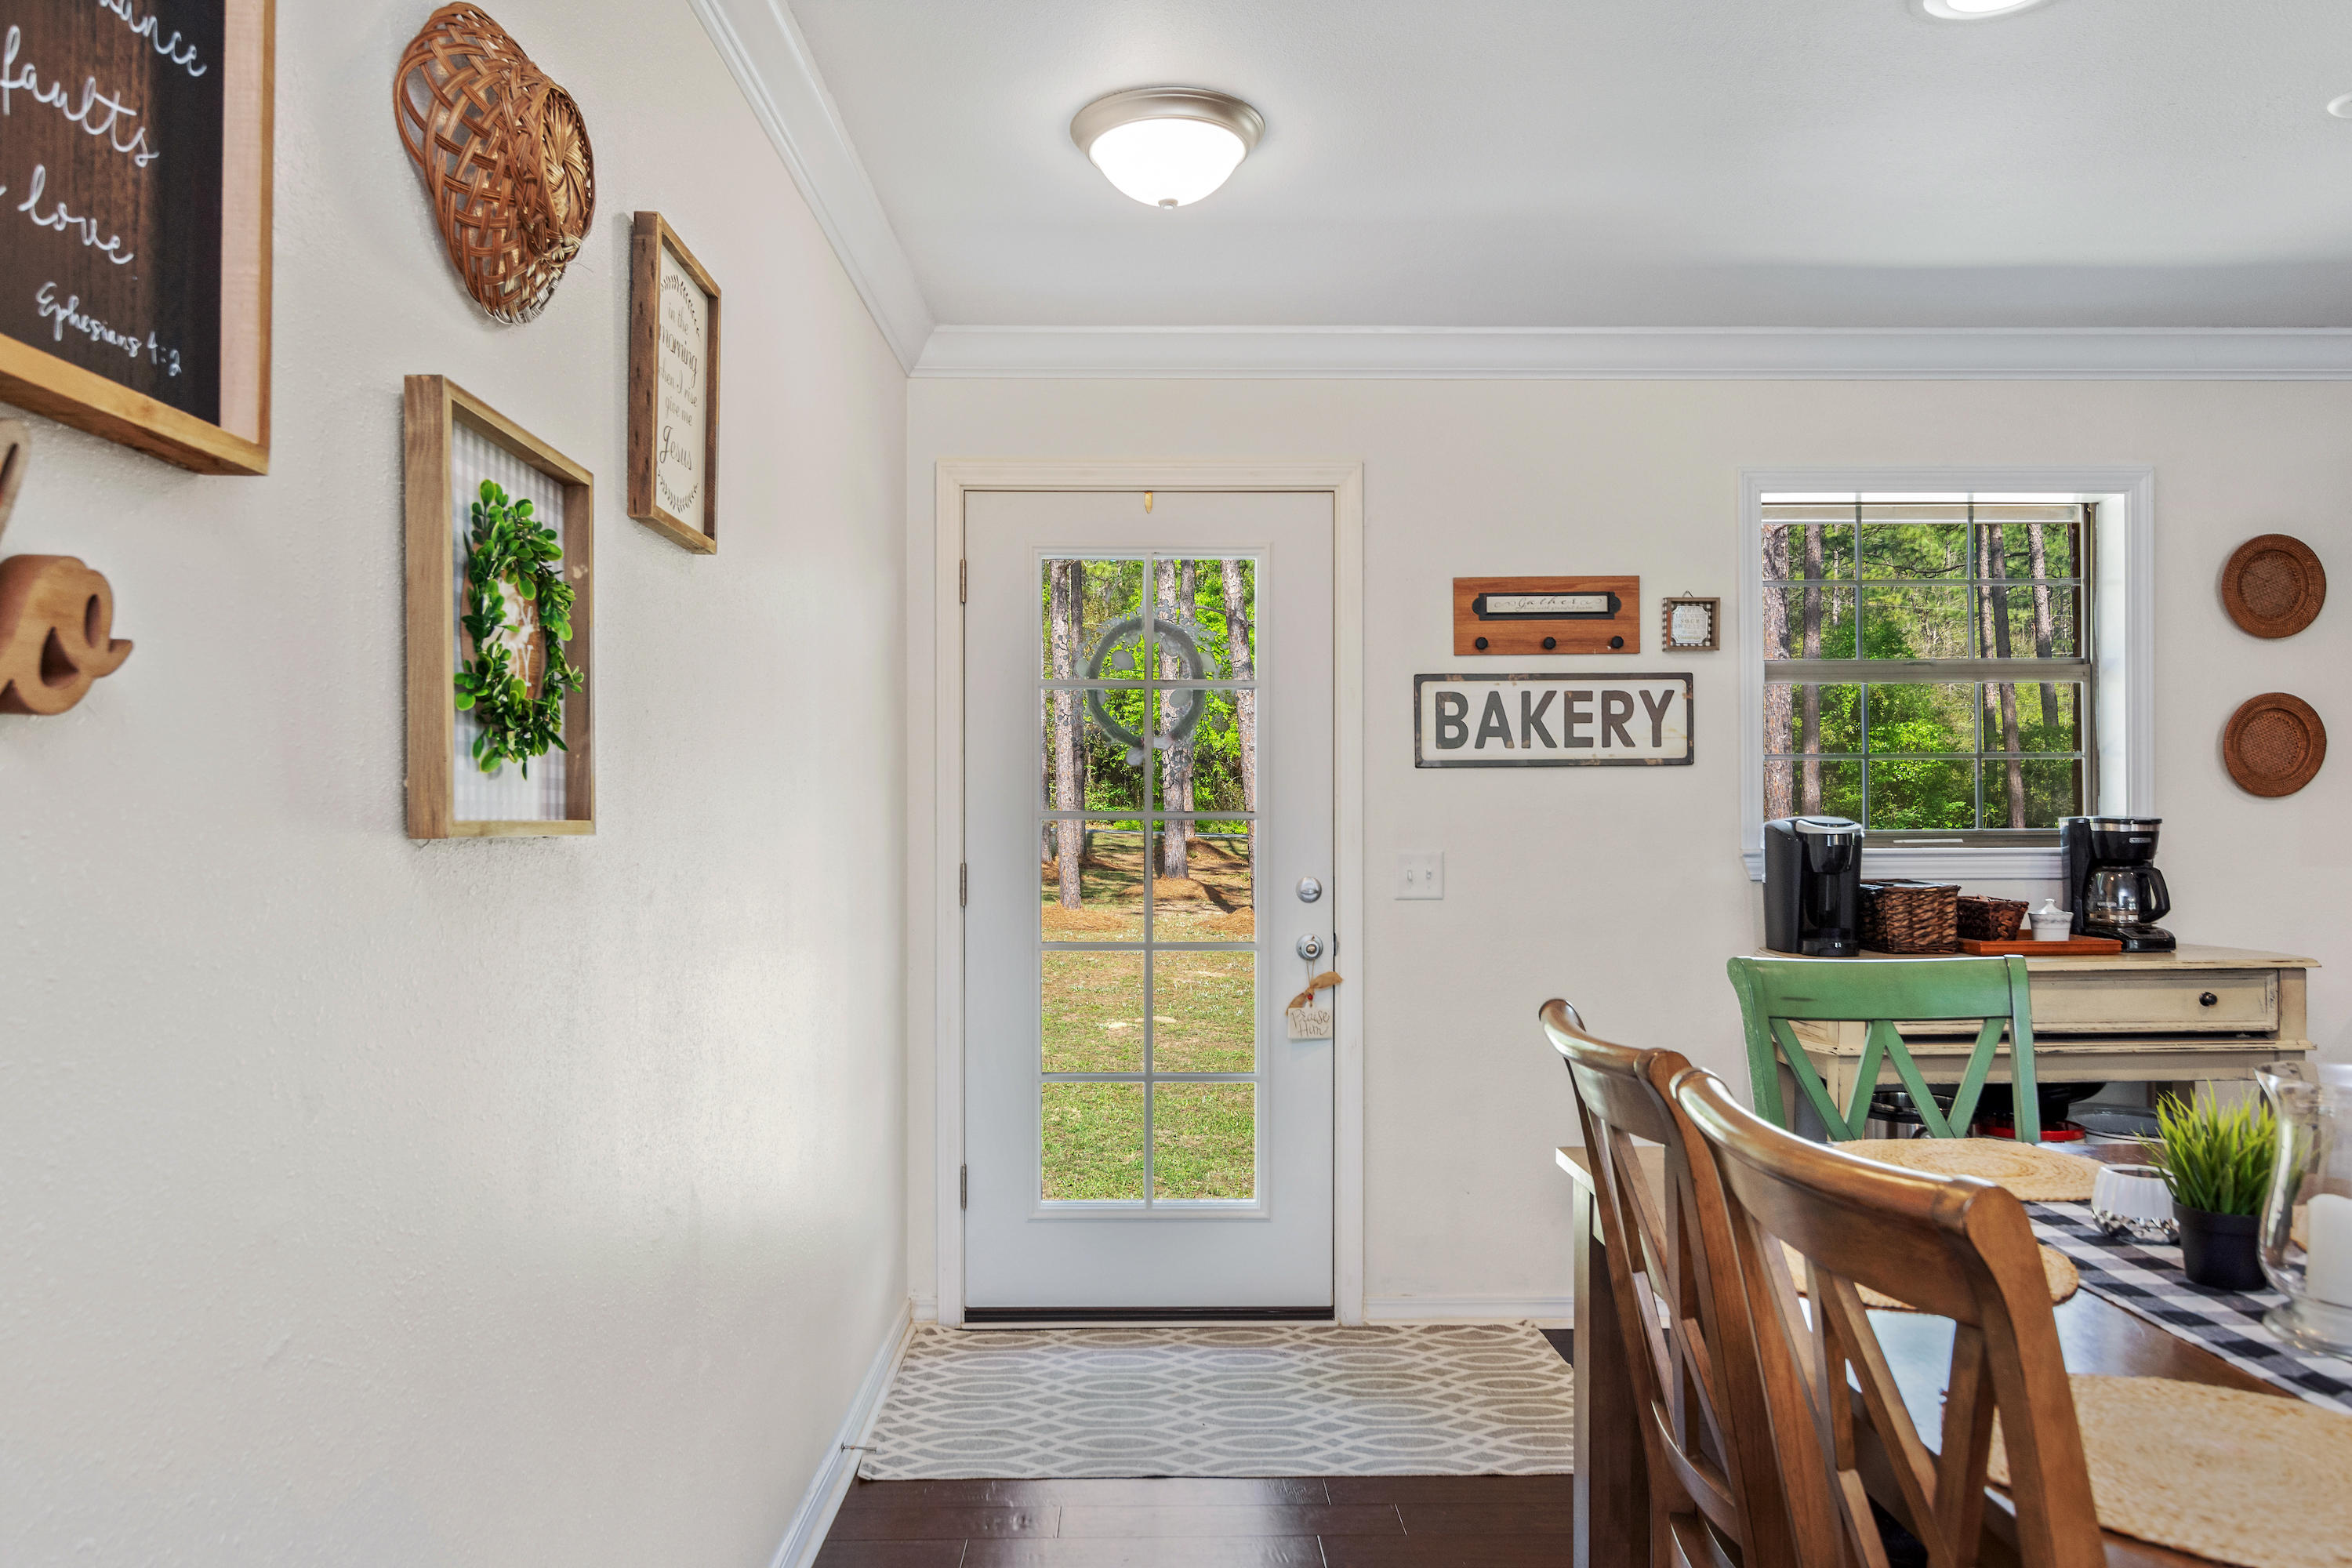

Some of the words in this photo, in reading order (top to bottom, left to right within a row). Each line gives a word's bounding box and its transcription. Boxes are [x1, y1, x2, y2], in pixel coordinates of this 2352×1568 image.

[100, 0, 208, 77] ance
[0, 24, 160, 168] faults
[35, 281, 142, 358] Ephesians
[147, 330, 182, 376] 4:2
[668, 302, 676, 322] in
[677, 307, 689, 336] the
[659, 322, 698, 388] morning
[665, 395, 680, 419] give
[681, 409, 692, 426] me
[684, 387, 697, 408] rise
[659, 425, 691, 470] Jesus
[1516, 596, 1576, 612] Gather
[1436, 690, 1675, 749] BAKERY
